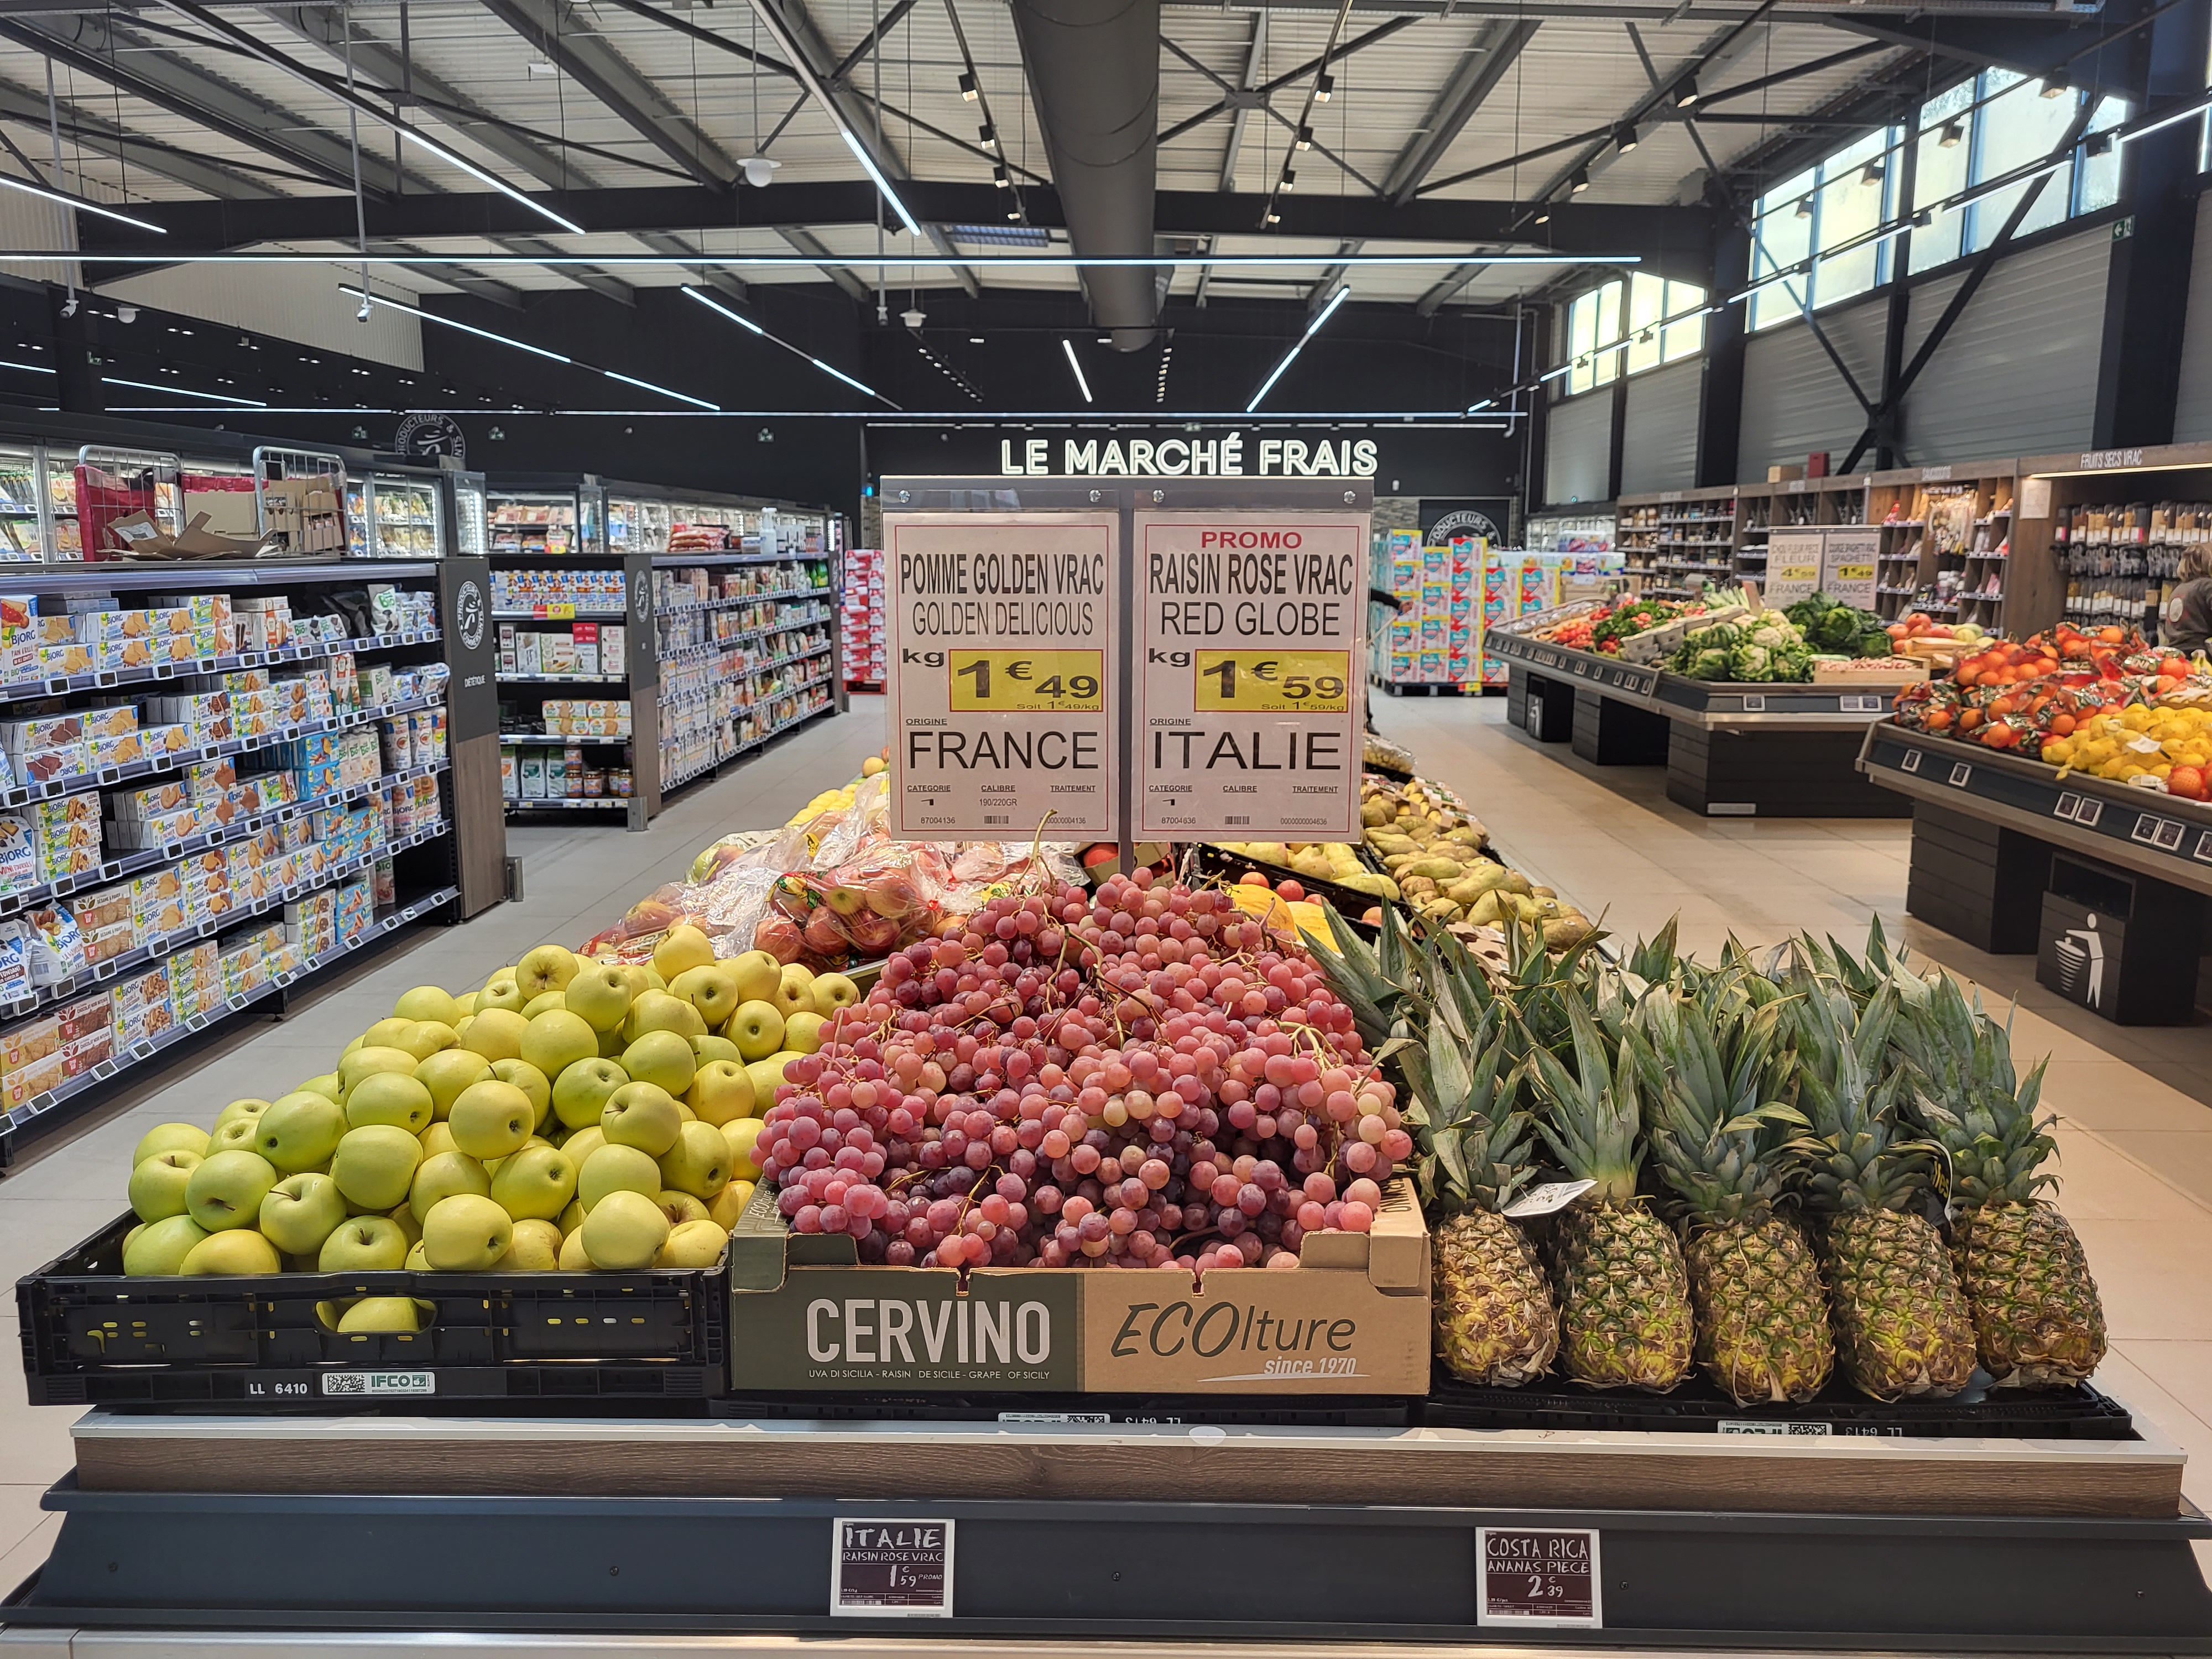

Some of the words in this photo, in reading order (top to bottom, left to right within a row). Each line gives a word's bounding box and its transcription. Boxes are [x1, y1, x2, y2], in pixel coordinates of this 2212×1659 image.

[1001, 439, 1048, 474] LE
[1065, 432, 1243, 475] MARCHÉ
[1259, 440, 1378, 476] FRAIS
[2080, 452, 2102, 469] FRUITS
[2104, 451, 2121, 467] SECS
[2124, 450, 2142, 466] VRAC
[1202, 531, 1302, 549] PROMO
[901, 553, 967, 594] POMME
[974, 553, 1048, 594] GOLDEN
[1054, 553, 1104, 594] VRAC
[1150, 553, 1220, 594] RAISIN
[1228, 554, 1287, 594] ROSE
[1295, 554, 1353, 595] VRAC
[1770, 583, 1813, 593] FRANCE
[1827, 582, 1871, 593] FRANCE
[913, 602, 988, 635] GOLDEN
[995, 602, 1093, 635] DELICIOUS
[1161, 602, 1224, 635] RED
[1235, 602, 1340, 636] GLOBE
[902, 649, 944, 667] kg
[1149, 648, 1190, 667] kg
[910, 732, 1098, 769] FRANCE
[1155, 732, 1340, 770] ITALIE
[1223, 785, 1258, 793] CALIBRE
[1292, 785, 1338, 794] TRAITEMENT
[979, 798, 1018, 807] 190/220GR
[807, 1298, 1050, 1364] CERVINO
[1264, 1355, 1313, 1374] since
[1319, 1357, 1357, 1375] 1970
[371, 1375, 411, 1387] IFCO
[809, 1370, 828, 1378] UVA
[831, 1370, 840, 1378] DI
[842, 1370, 873, 1378] SICILIA
[883, 1370, 911, 1379] RAISIN
[919, 1370, 931, 1379] DE
[933, 1370, 961, 1379] SICILE
[969, 1371, 1000, 1379] GRAPE
[1008, 1371, 1021, 1379] OF
[1023, 1371, 1050, 1380] SICILY
[250, 1383, 265, 1394] LL
[275, 1383, 307, 1394] 6410
[846, 1527, 941, 1549] ITALIE
[843, 1551, 879, 1562] RAISIN
[880, 1552, 909, 1562] ROSE
[911, 1552, 943, 1562] VRAC
[1487, 1538, 1541, 1559] COSTA
[1548, 1538, 1589, 1561] RICA
[1487, 1560, 1542, 1573] ANANAS
[1547, 1561, 1589, 1574] PIECE
